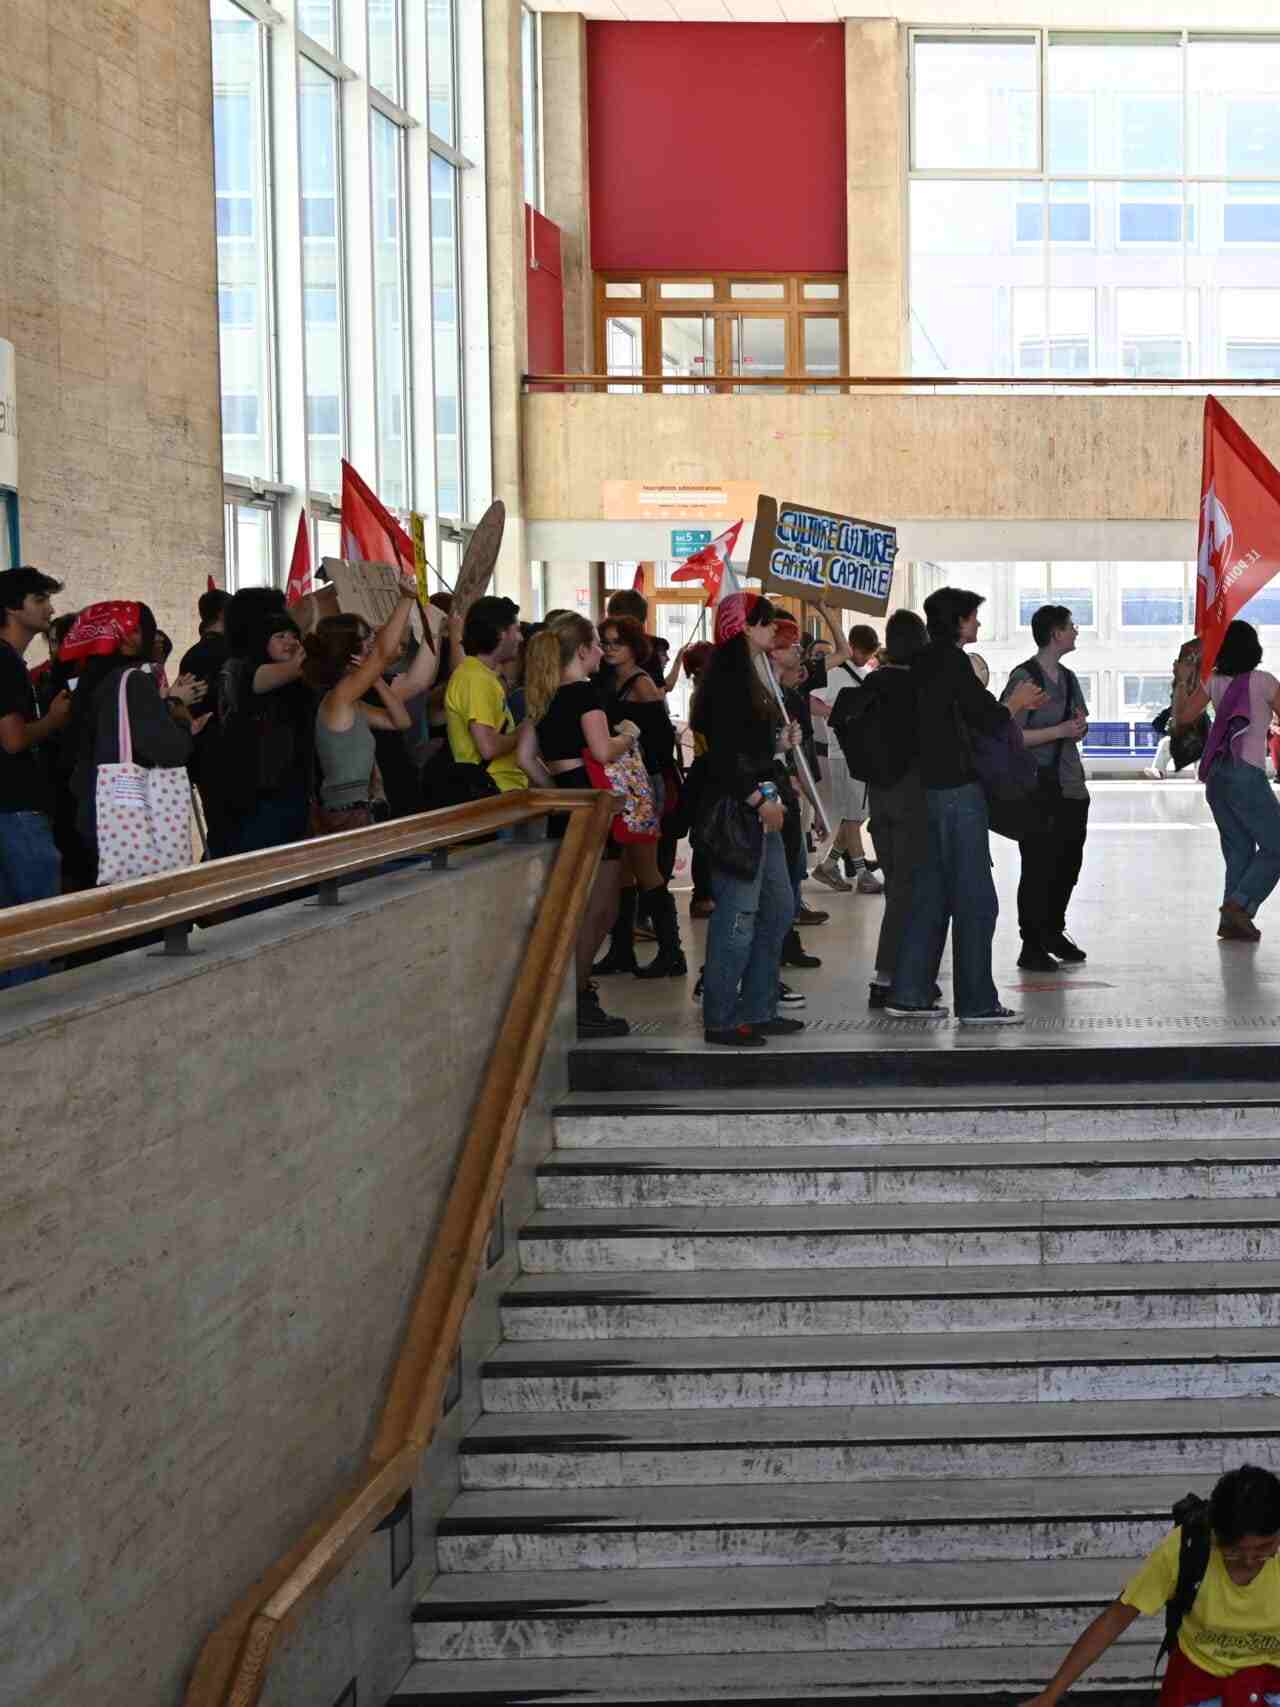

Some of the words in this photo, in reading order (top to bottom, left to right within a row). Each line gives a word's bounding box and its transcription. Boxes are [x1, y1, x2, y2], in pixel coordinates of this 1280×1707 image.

[777, 511, 836, 551] CULTURE
[836, 521, 894, 564] CULTURE
[771, 551, 825, 585] CAPITAL
[829, 558, 890, 596] CAPITALE
